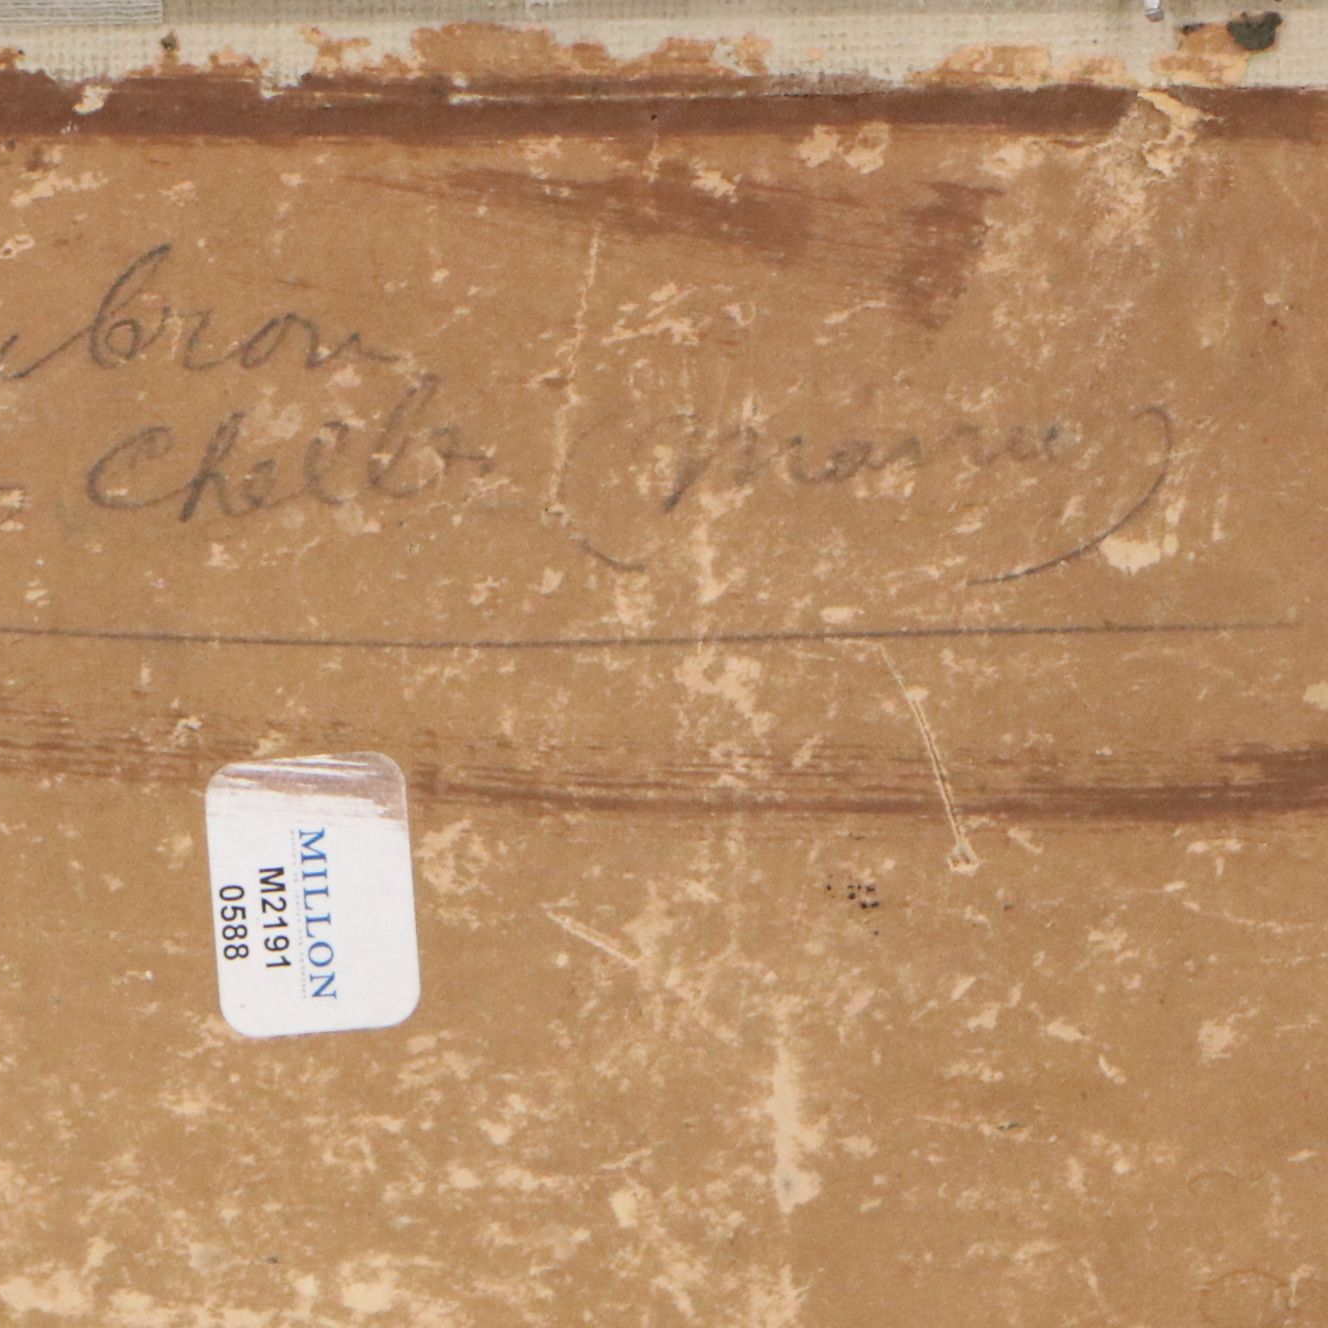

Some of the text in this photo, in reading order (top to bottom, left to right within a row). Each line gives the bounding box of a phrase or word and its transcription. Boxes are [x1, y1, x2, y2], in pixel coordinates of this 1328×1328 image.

[218, 884, 250, 961] 0588
[258, 866, 292, 969] M2191
[298, 827, 338, 1000] MILLON
